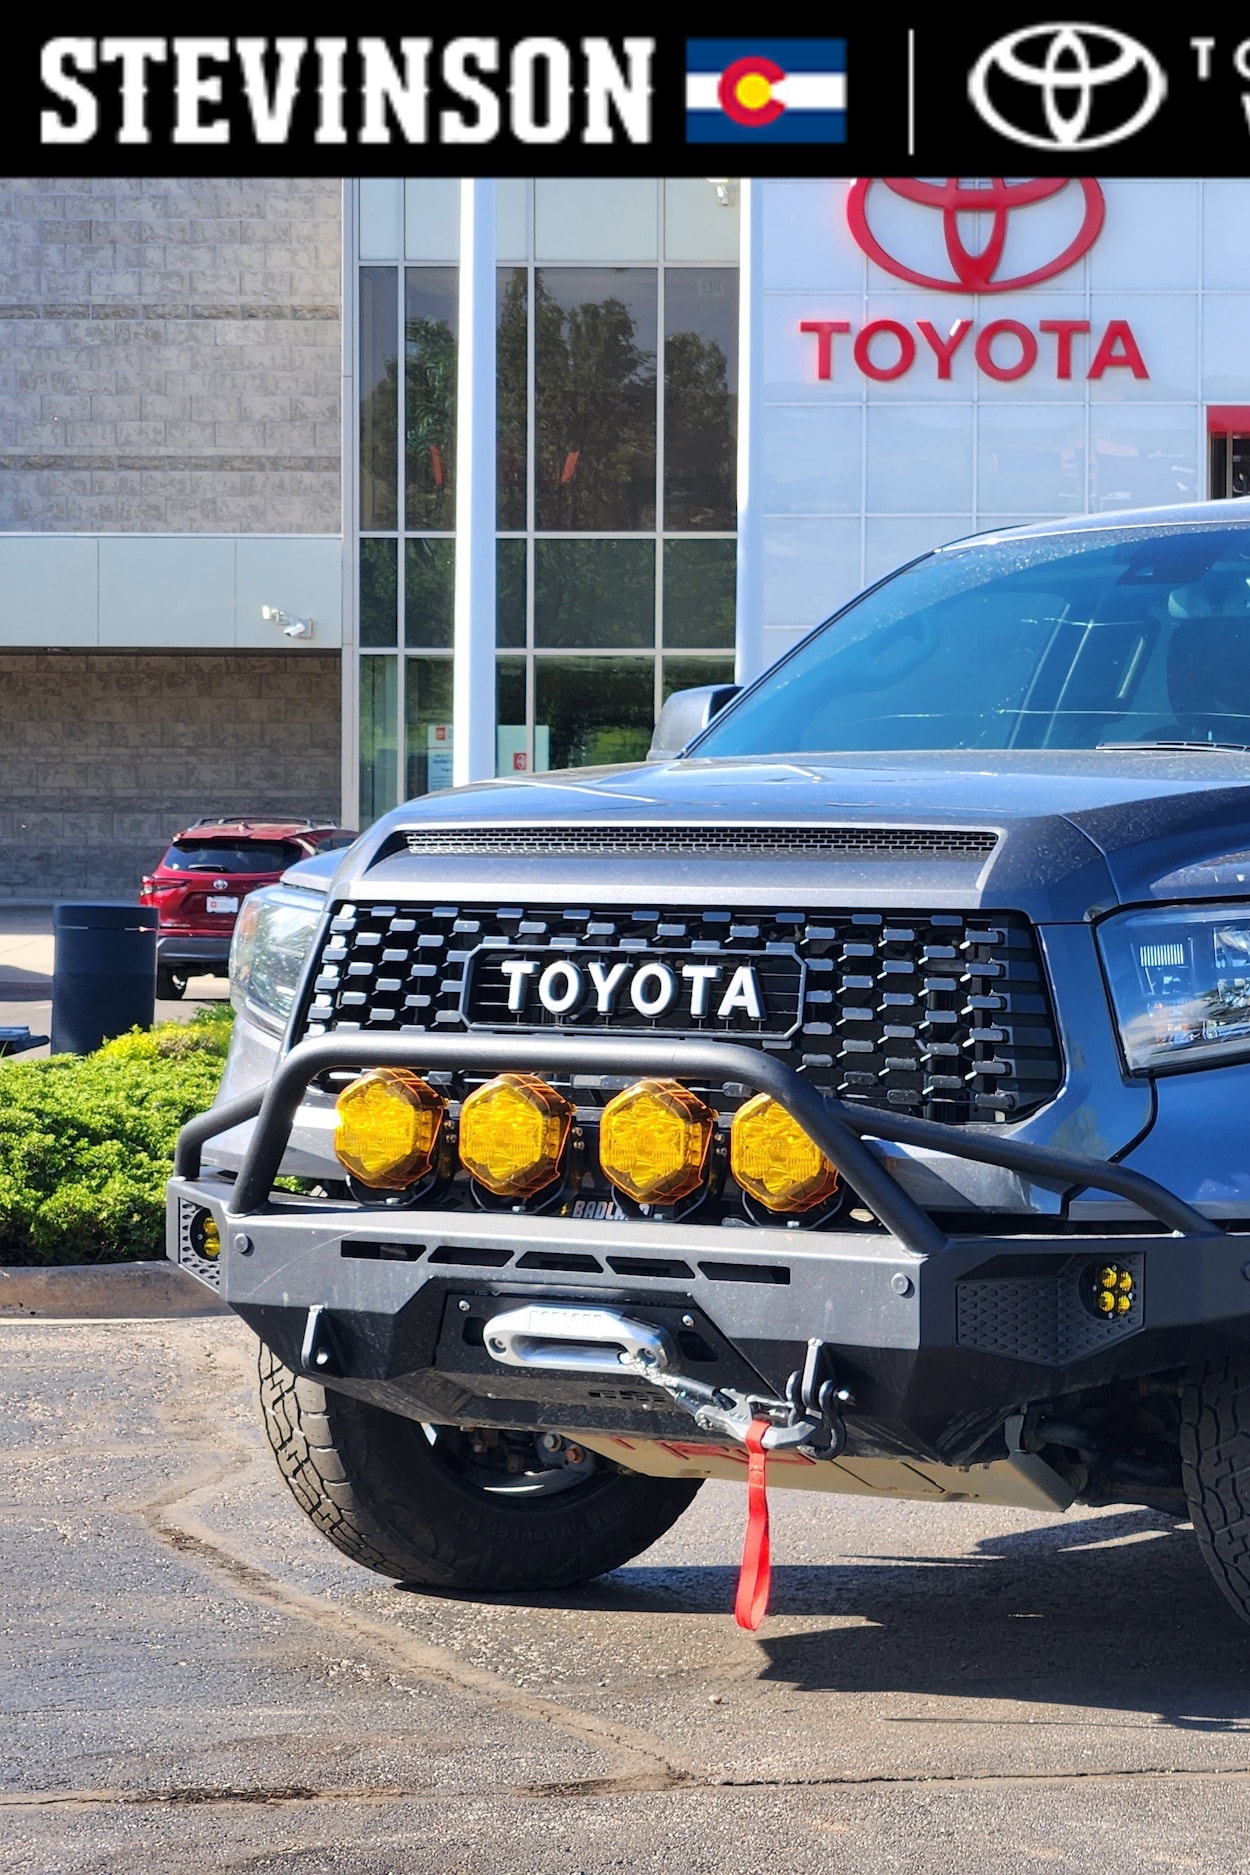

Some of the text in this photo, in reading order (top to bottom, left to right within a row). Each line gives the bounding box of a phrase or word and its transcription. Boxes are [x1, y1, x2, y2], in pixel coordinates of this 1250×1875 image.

[800, 319, 1150, 382] TOYOTA
[501, 960, 767, 1021] TOYOTA
[572, 1200, 651, 1221] BADLA
